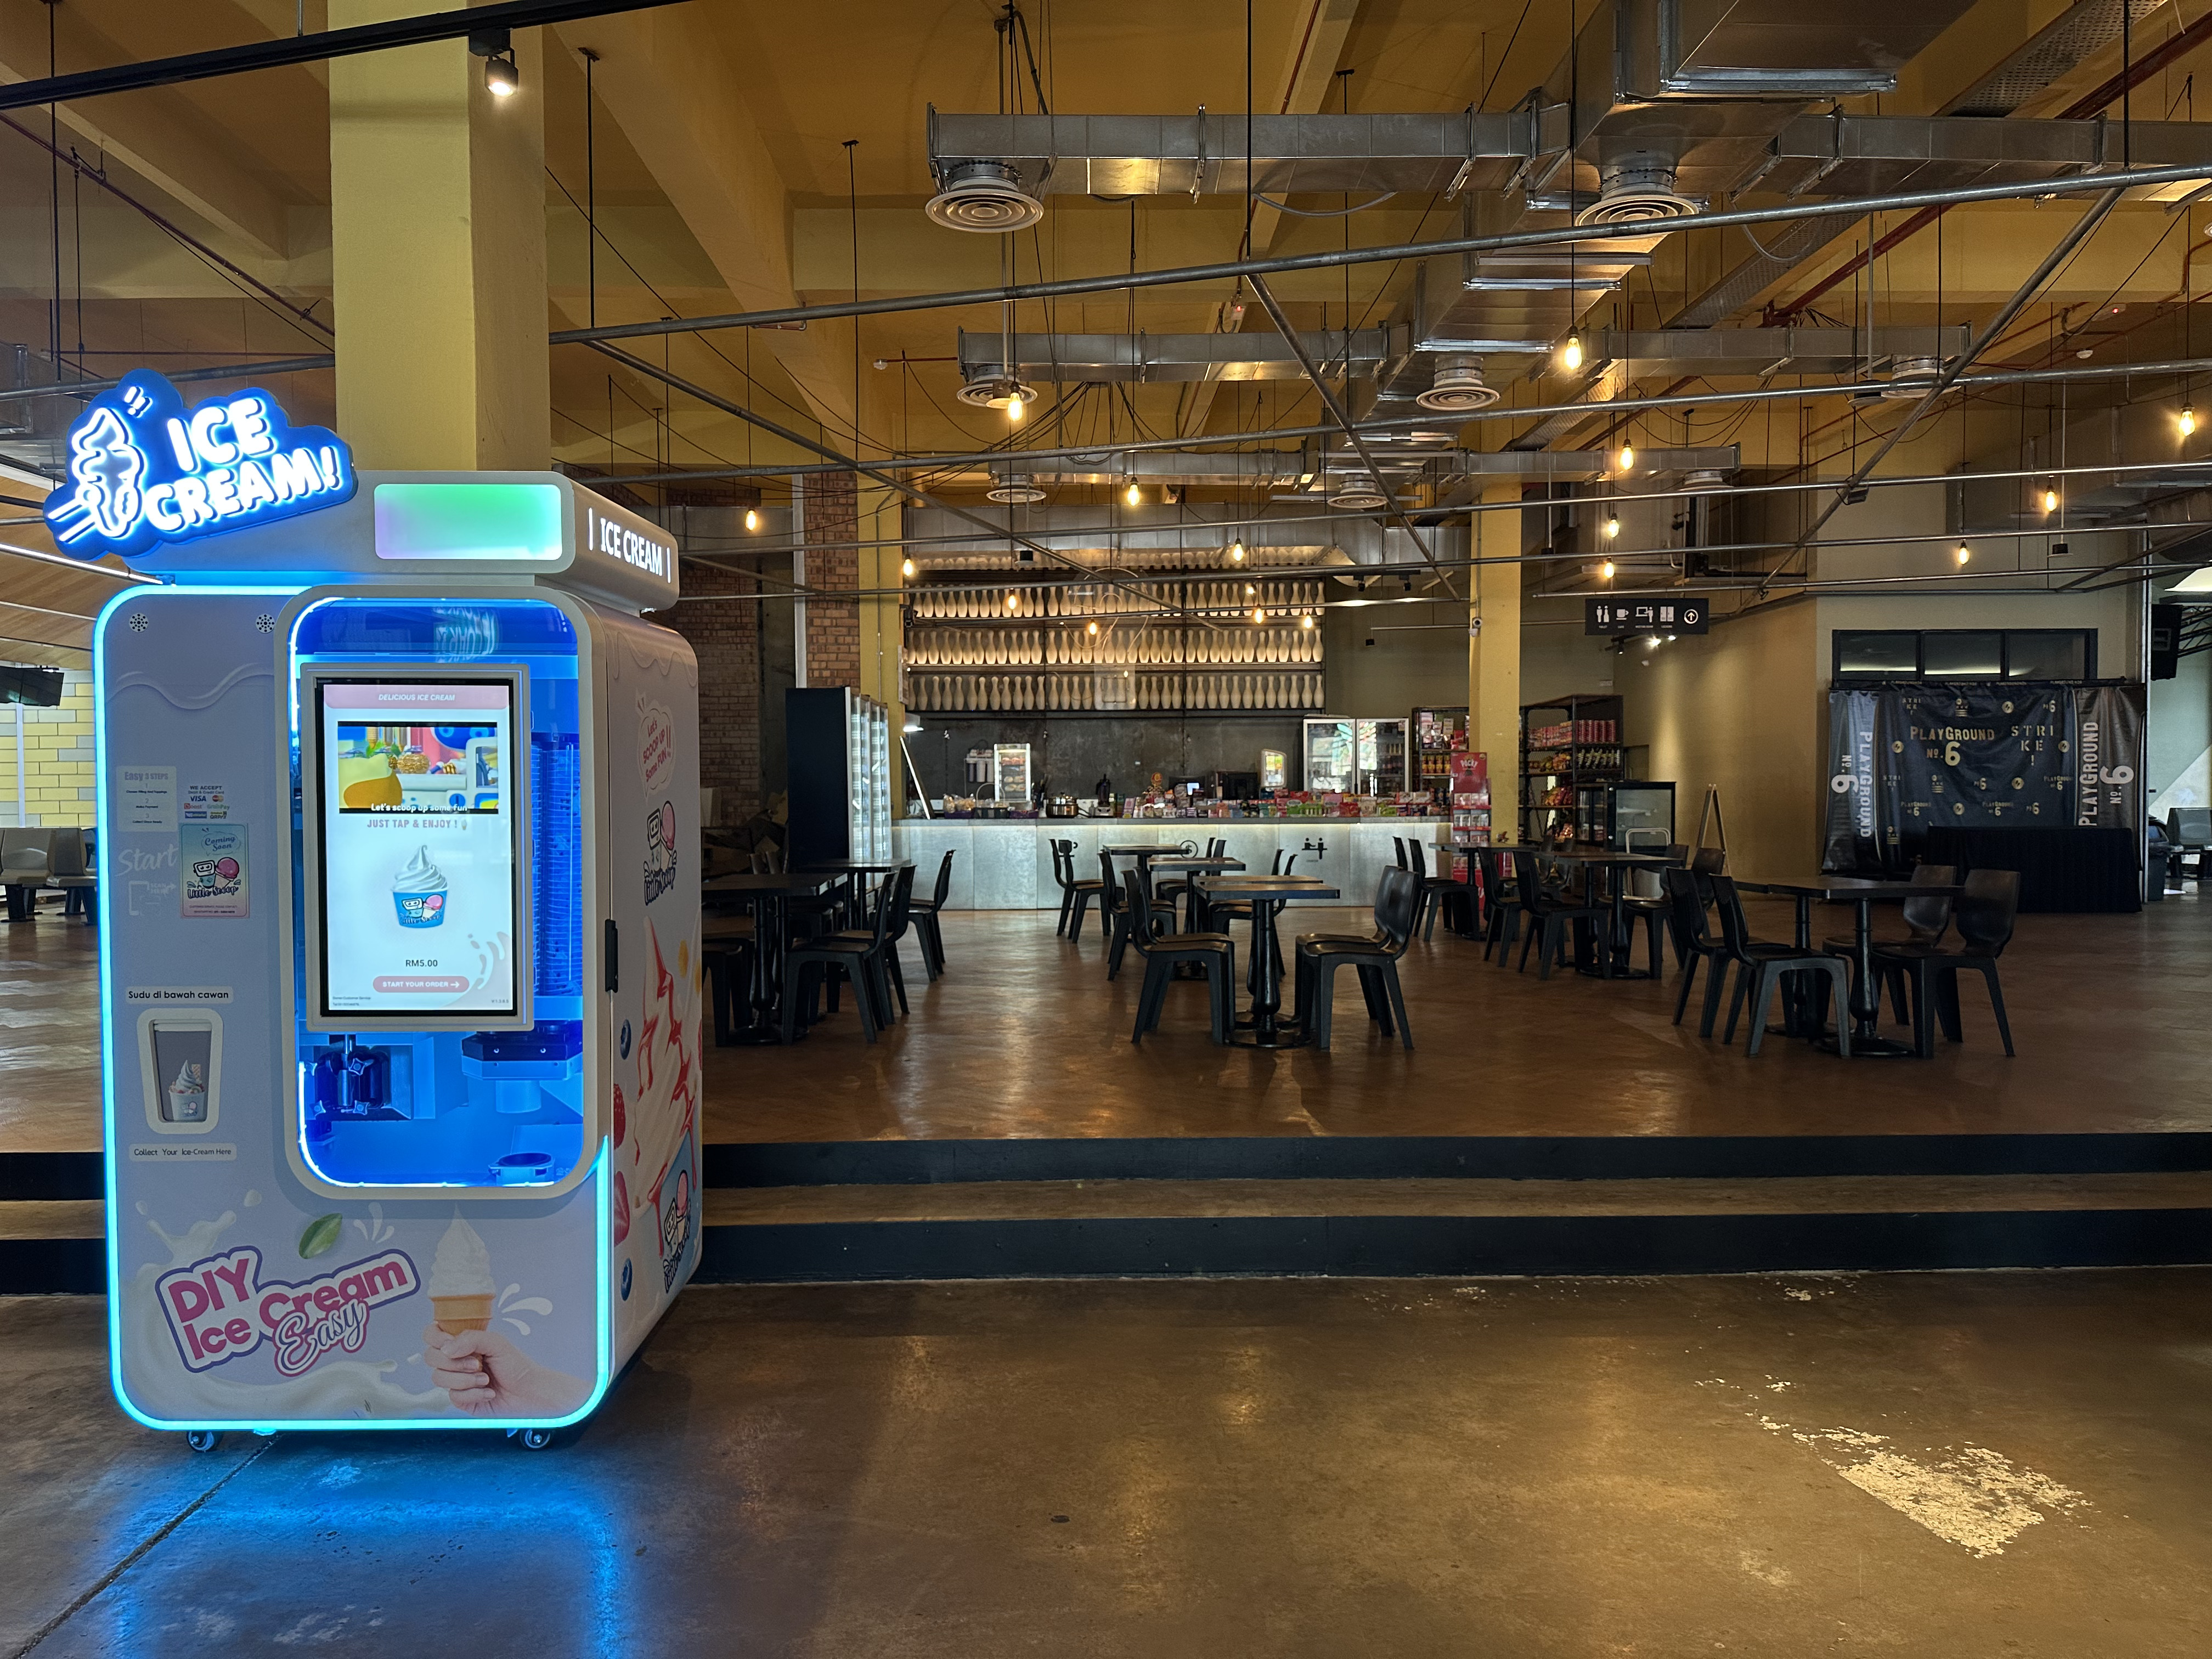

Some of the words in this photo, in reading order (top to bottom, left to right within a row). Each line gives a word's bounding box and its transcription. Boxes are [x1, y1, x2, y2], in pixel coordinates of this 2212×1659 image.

[167, 398, 275, 472] ICE
[145, 446, 341, 532] CREAM!
[600, 518, 620, 559] ICE
[623, 530, 663, 576] CREAM
[648, 717, 657, 737] Let's
[1910, 726, 1995, 740] PLAYGROUND
[643, 736, 658, 764] SCOOP
[659, 729, 665, 744] UP
[1945, 741, 1961, 766] 6
[125, 771, 143, 781] Easy
[1831, 774, 1859, 793] 6
[1859, 731, 1873, 837] PLAYGROUND
[2078, 722, 2098, 826] PLAYGROUND
[2100, 765, 2134, 784] 6
[392, 805, 416, 813] scoop
[418, 805, 428, 813] up
[367, 820, 390, 828] JUST
[392, 820, 409, 828] TAP
[413, 820, 419, 828] &
[422, 820, 451, 828] ENJOY
[205, 837, 235, 845] Coming
[212, 843, 232, 851] Soon
[115, 844, 178, 877] Start
[168, 1259, 250, 1323] DIY
[183, 1318, 251, 1360] Ice
[259, 1261, 408, 1330] Cream
[277, 1298, 367, 1375] Easy
